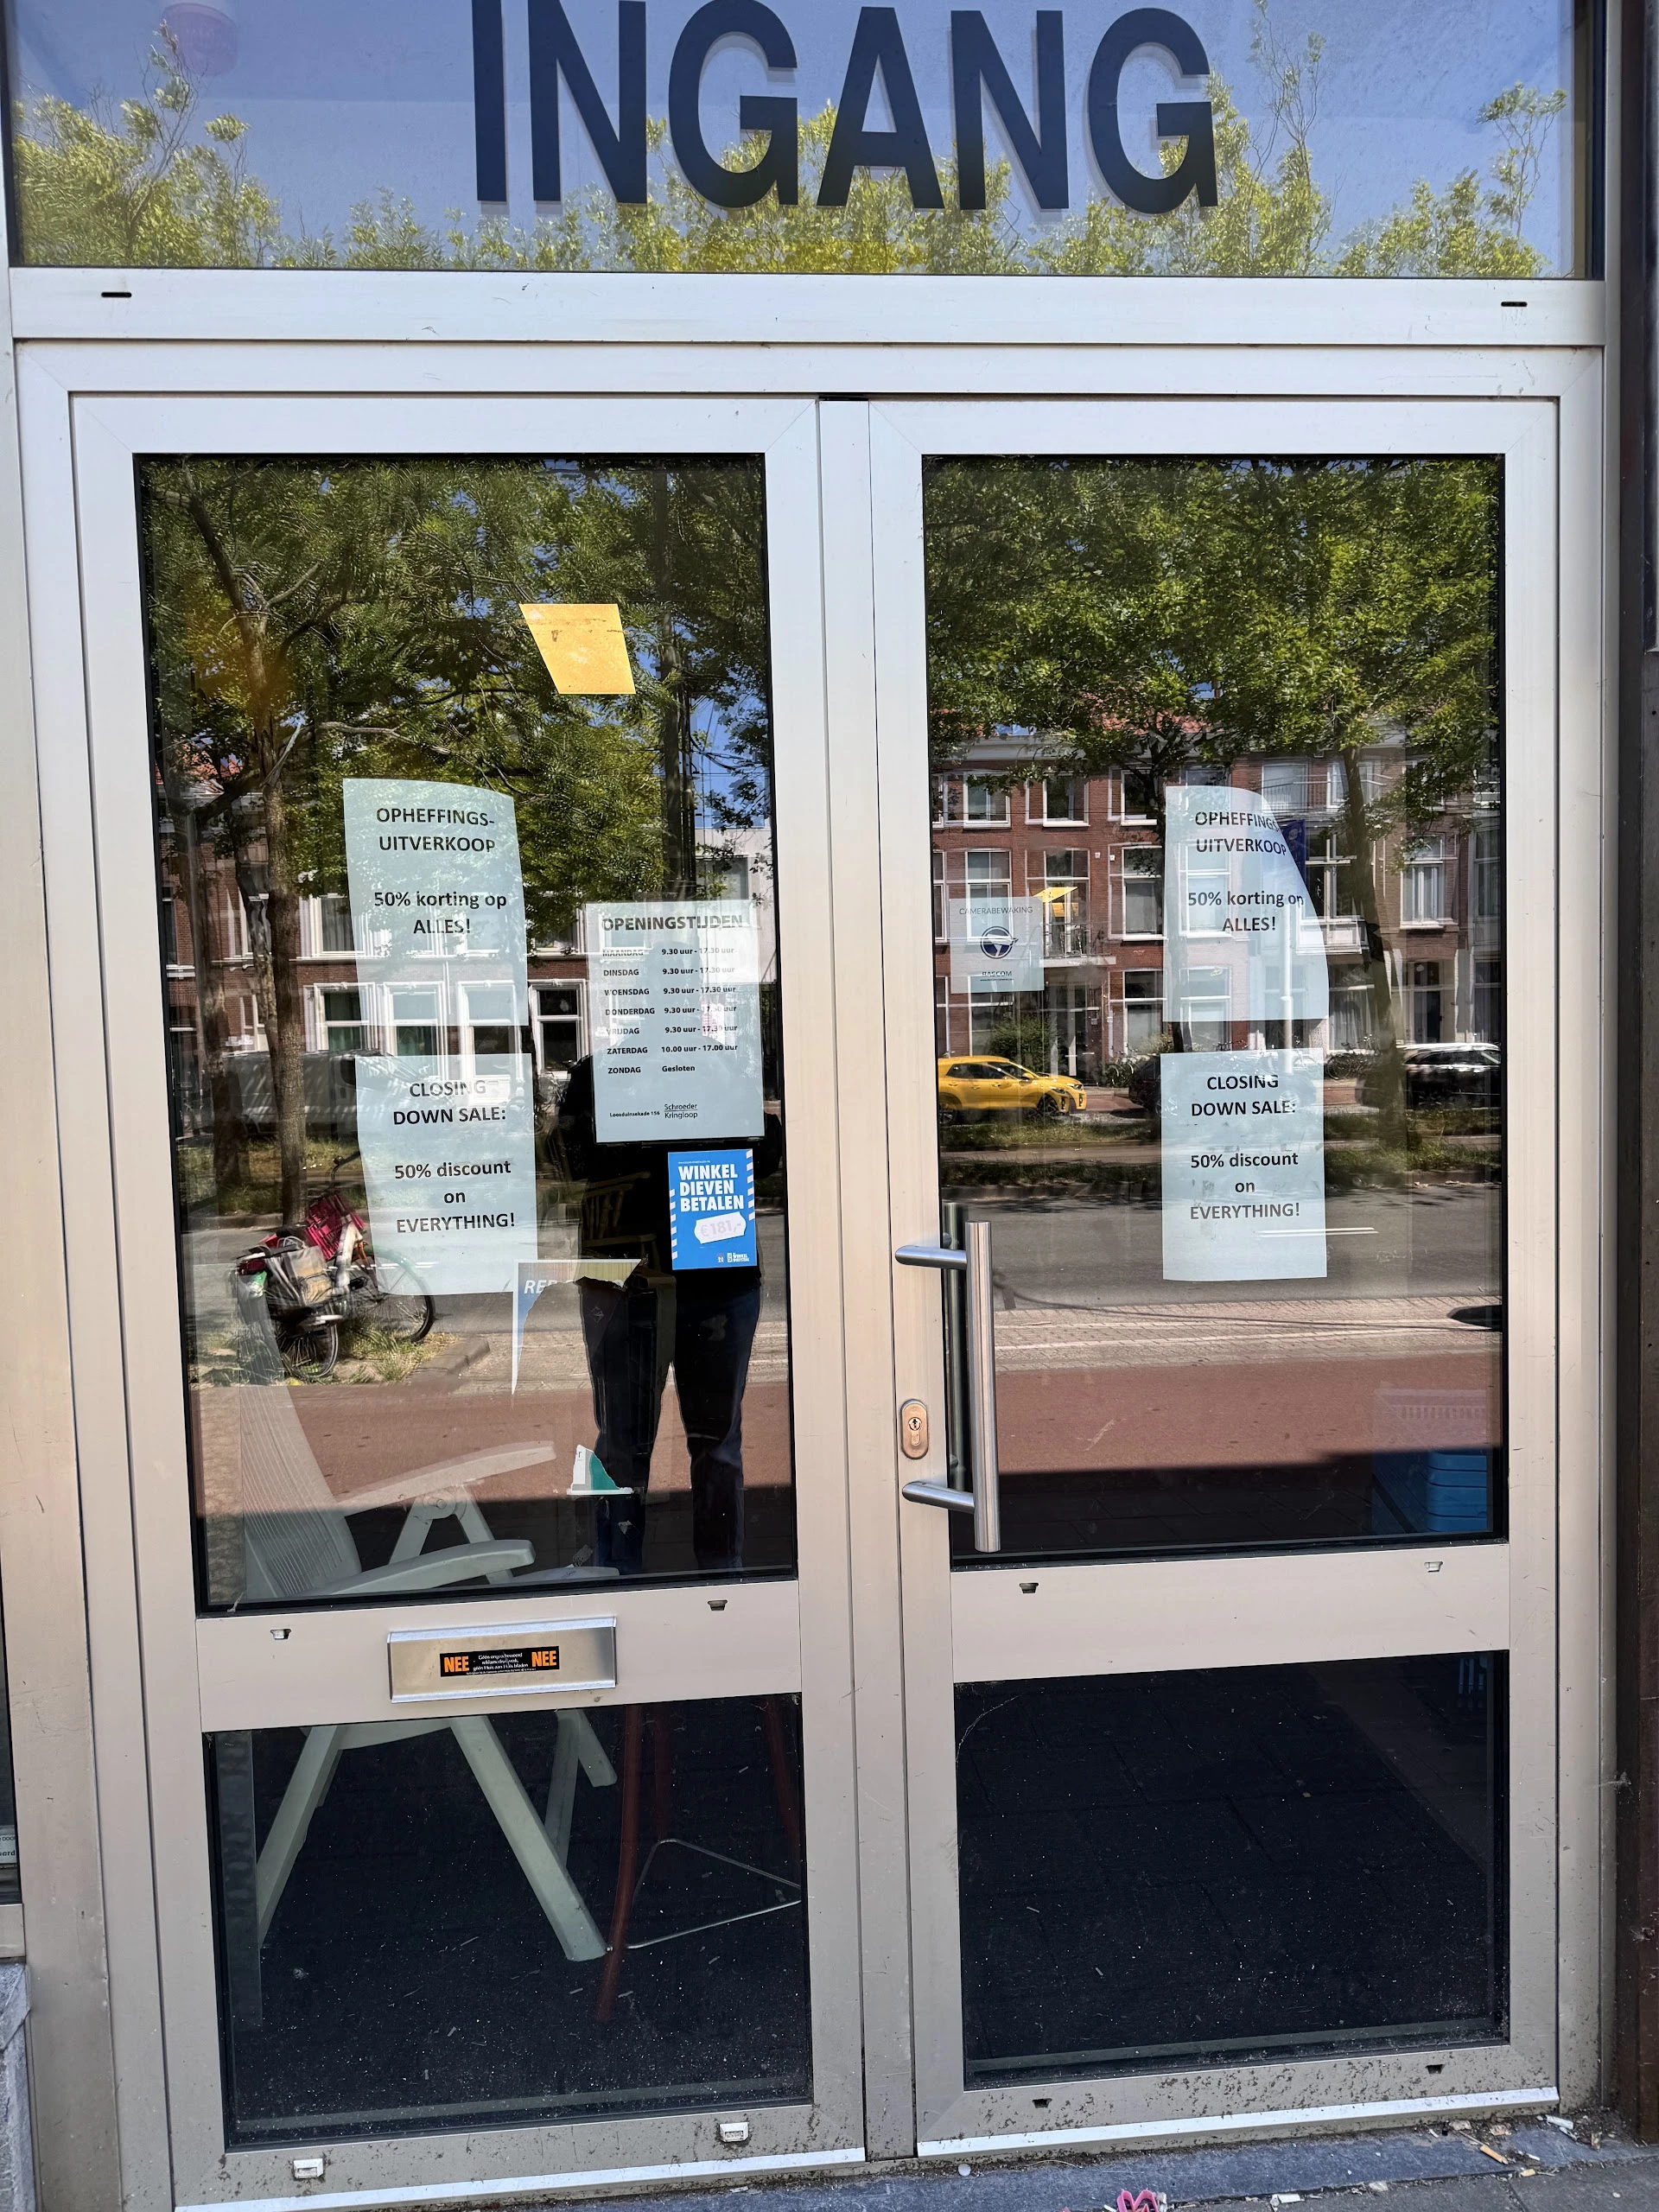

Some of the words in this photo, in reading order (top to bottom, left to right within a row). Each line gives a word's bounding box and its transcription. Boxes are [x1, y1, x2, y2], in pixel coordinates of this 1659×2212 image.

[471, 0, 1218, 214] INGANG
[377, 808, 495, 826] OPHEFFINGS-
[379, 836, 495, 852] UITVERKOOP
[1196, 838, 1287, 855] UITVERKOOP
[374, 892, 410, 906] 50%
[416, 892, 479, 908] korting
[486, 894, 506, 909] op
[1188, 892, 1222, 906] 50%
[1227, 891, 1283, 908] korting
[959, 906, 1033, 915] CAMERABEWAKING
[413, 918, 470, 934] ALLES!
[602, 915, 742, 931] OPENINGSTIJDEN
[1222, 918, 1276, 931] ALLES!
[410, 1080, 486, 1097] CLOSING
[1207, 1075, 1279, 1090] CLOSING
[393, 1109, 453, 1125] DOWN
[459, 1107, 506, 1122] SALE:
[1192, 1102, 1246, 1116] DOWN
[1252, 1100, 1295, 1115] SALE:
[1191, 1154, 1224, 1168] 50%
[1230, 1153, 1299, 1166] discount
[395, 1164, 431, 1179] 50%
[437, 1160, 512, 1177] discount
[678, 1164, 738, 1180] WINKEL
[680, 1180, 734, 1196] DIEVEN
[1235, 1181, 1255, 1193] on
[444, 1192, 466, 1204] on
[681, 1195, 744, 1212] BETALEN
[1191, 1203, 1300, 1219] EVERYTHING!
[397, 1213, 515, 1233] EVERYTHING!
[444, 1656, 469, 1672] NEE
[531, 1650, 556, 1667] NEE
